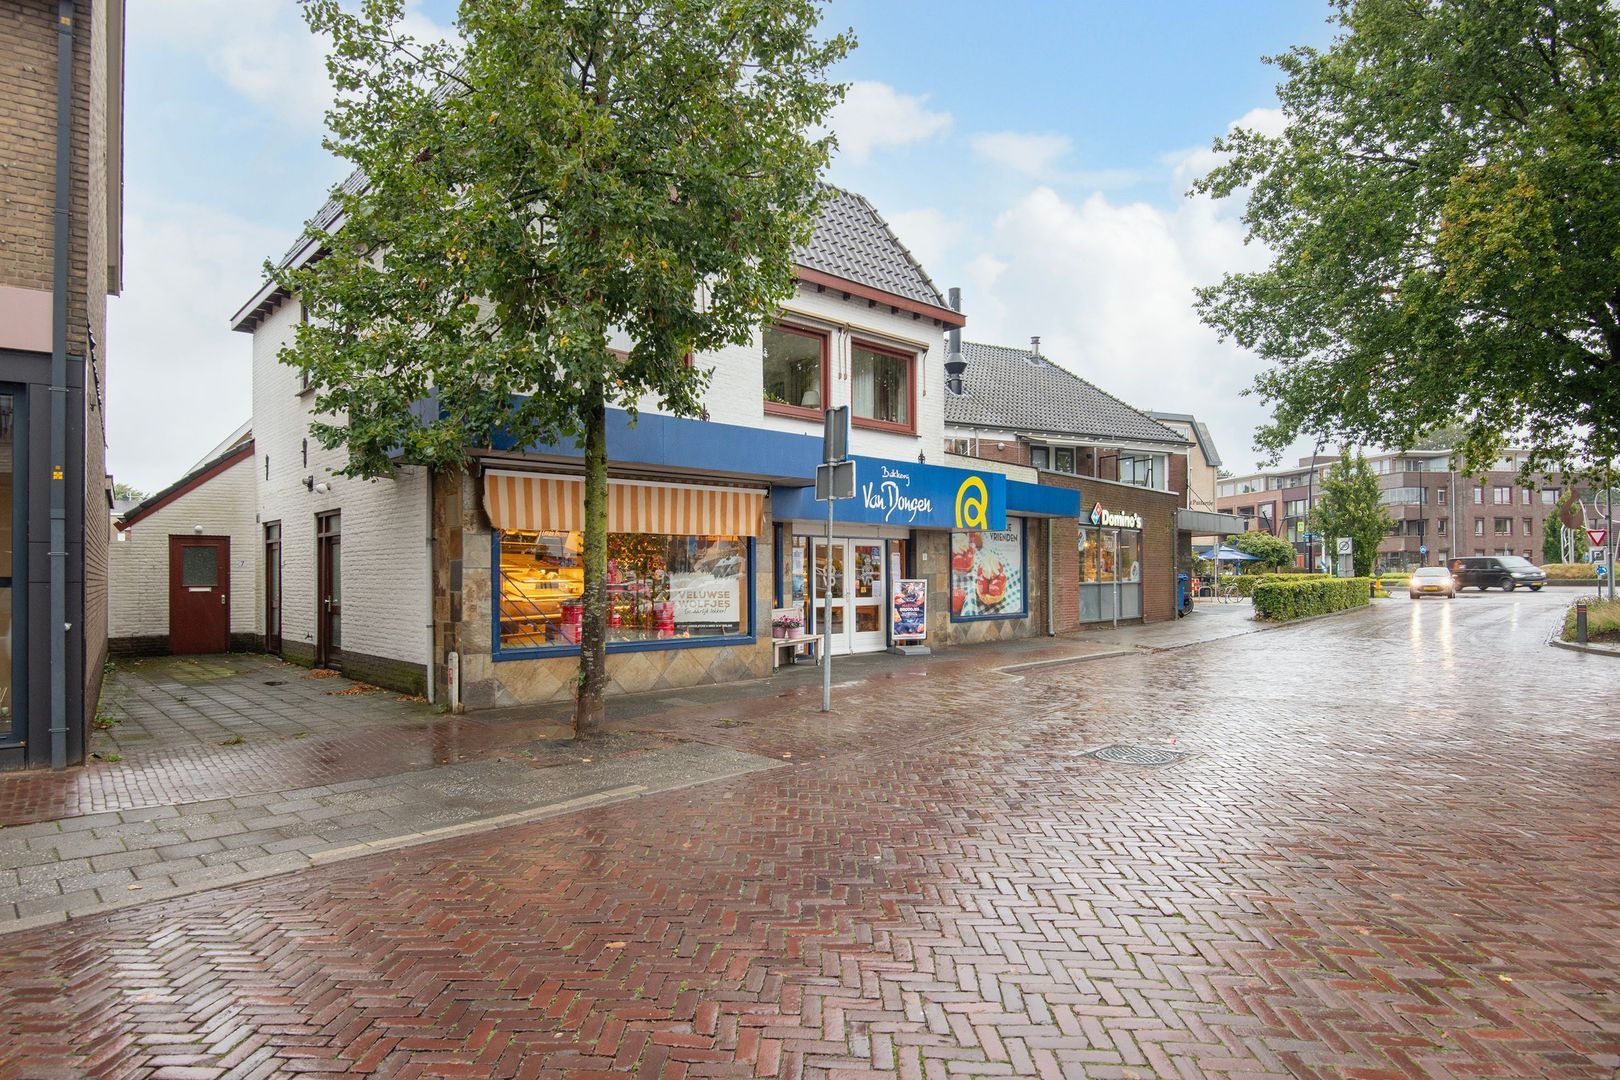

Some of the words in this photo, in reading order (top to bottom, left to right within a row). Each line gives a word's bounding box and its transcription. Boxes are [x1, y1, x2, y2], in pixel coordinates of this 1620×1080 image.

[863, 482, 886, 510] Van
[881, 481, 933, 522] Dongen
[1101, 509, 1142, 529] Domino's
[990, 532, 1018, 542] VRIENDEN
[678, 591, 730, 599] VELUWSE
[678, 600, 731, 608] WOLFJES
